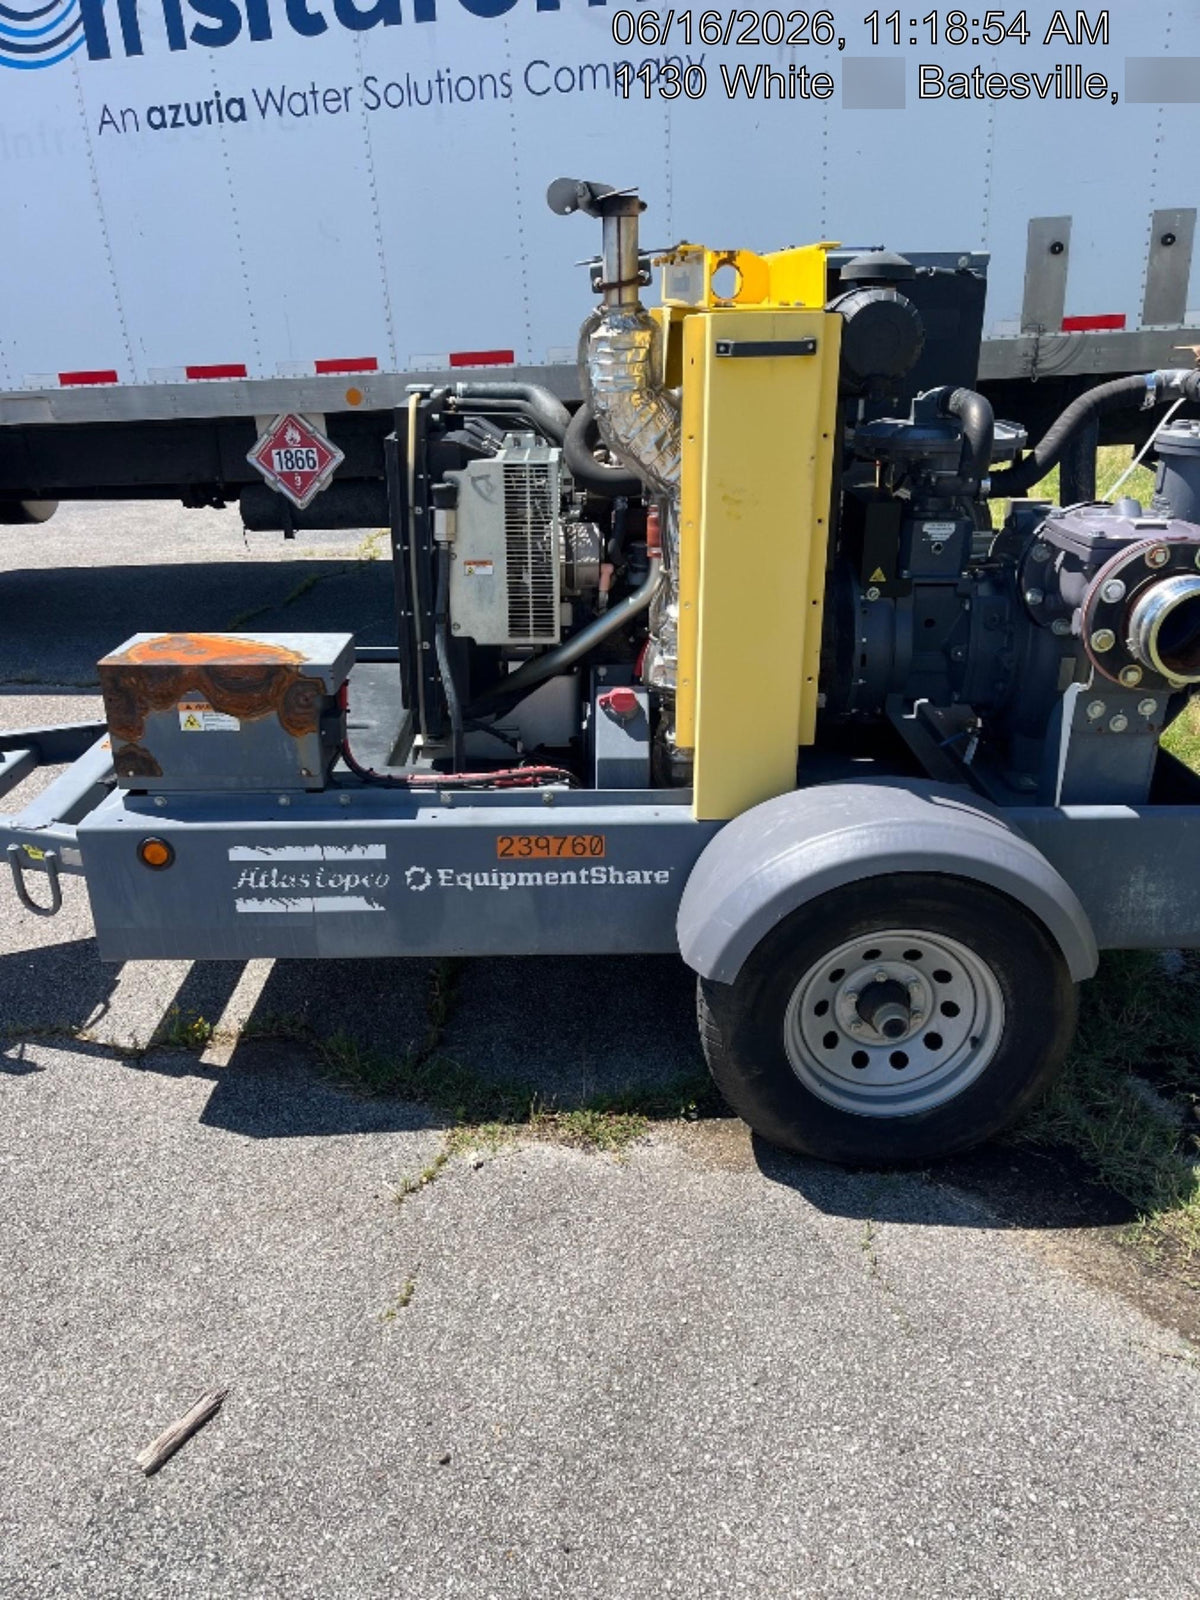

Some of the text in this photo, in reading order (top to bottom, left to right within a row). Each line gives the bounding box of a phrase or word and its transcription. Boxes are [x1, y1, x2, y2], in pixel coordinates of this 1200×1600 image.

[97, 104, 141, 135] An
[146, 91, 247, 131] azuria
[252, 82, 353, 120] Water
[362, 68, 512, 110] Solutions
[275, 449, 316, 470] 1866
[295, 476, 301, 486] 3
[498, 835, 604, 857] 239760
[437, 865, 670, 890] EquipmentShare
